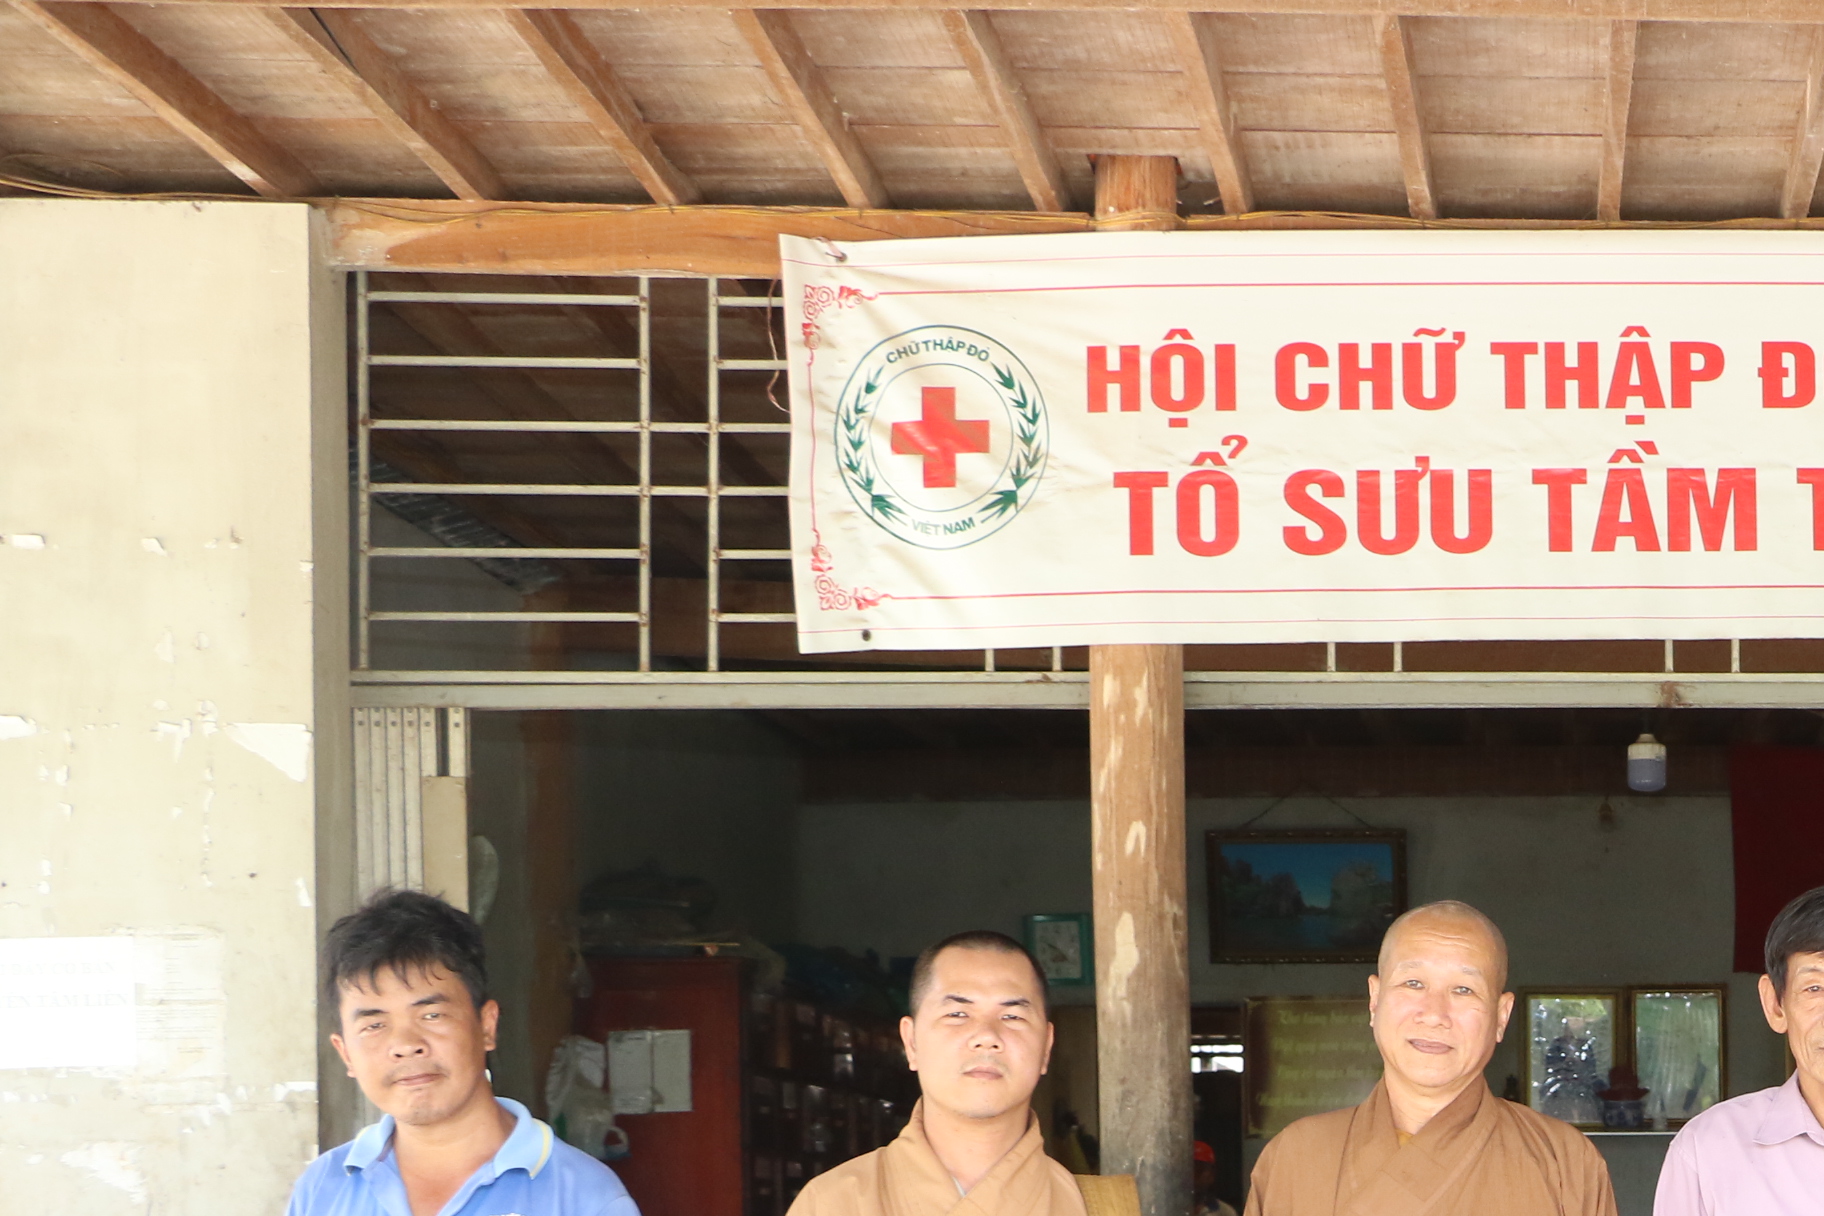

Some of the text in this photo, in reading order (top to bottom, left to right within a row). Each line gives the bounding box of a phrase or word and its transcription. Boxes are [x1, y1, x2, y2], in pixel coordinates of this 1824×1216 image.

[1088, 329, 1237, 428] HỘI
[1275, 327, 1467, 412] CHỮ
[1491, 325, 1725, 425] THẬP
[943, 516, 976, 535] NAM
[1113, 435, 1249, 556] TỔ
[1283, 456, 1494, 556] SƯU
[1532, 440, 1758, 554] TẦM
